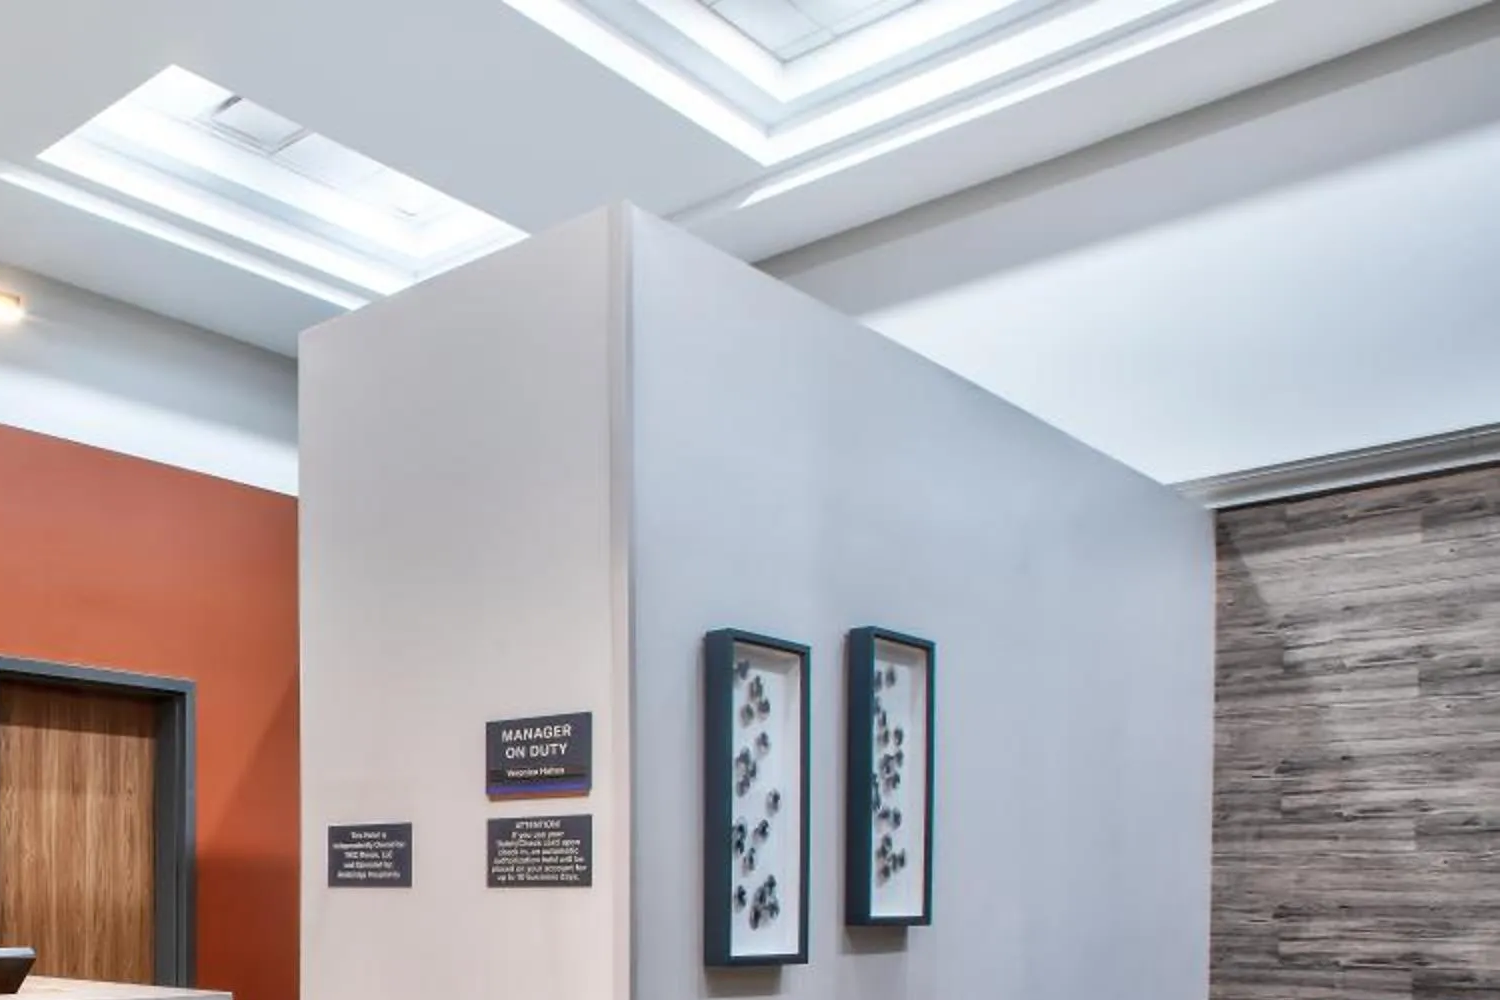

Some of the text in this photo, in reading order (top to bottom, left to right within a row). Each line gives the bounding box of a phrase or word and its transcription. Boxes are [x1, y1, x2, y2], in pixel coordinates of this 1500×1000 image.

[501, 723, 572, 743] MANAGER
[505, 742, 569, 759] ON DUTY
